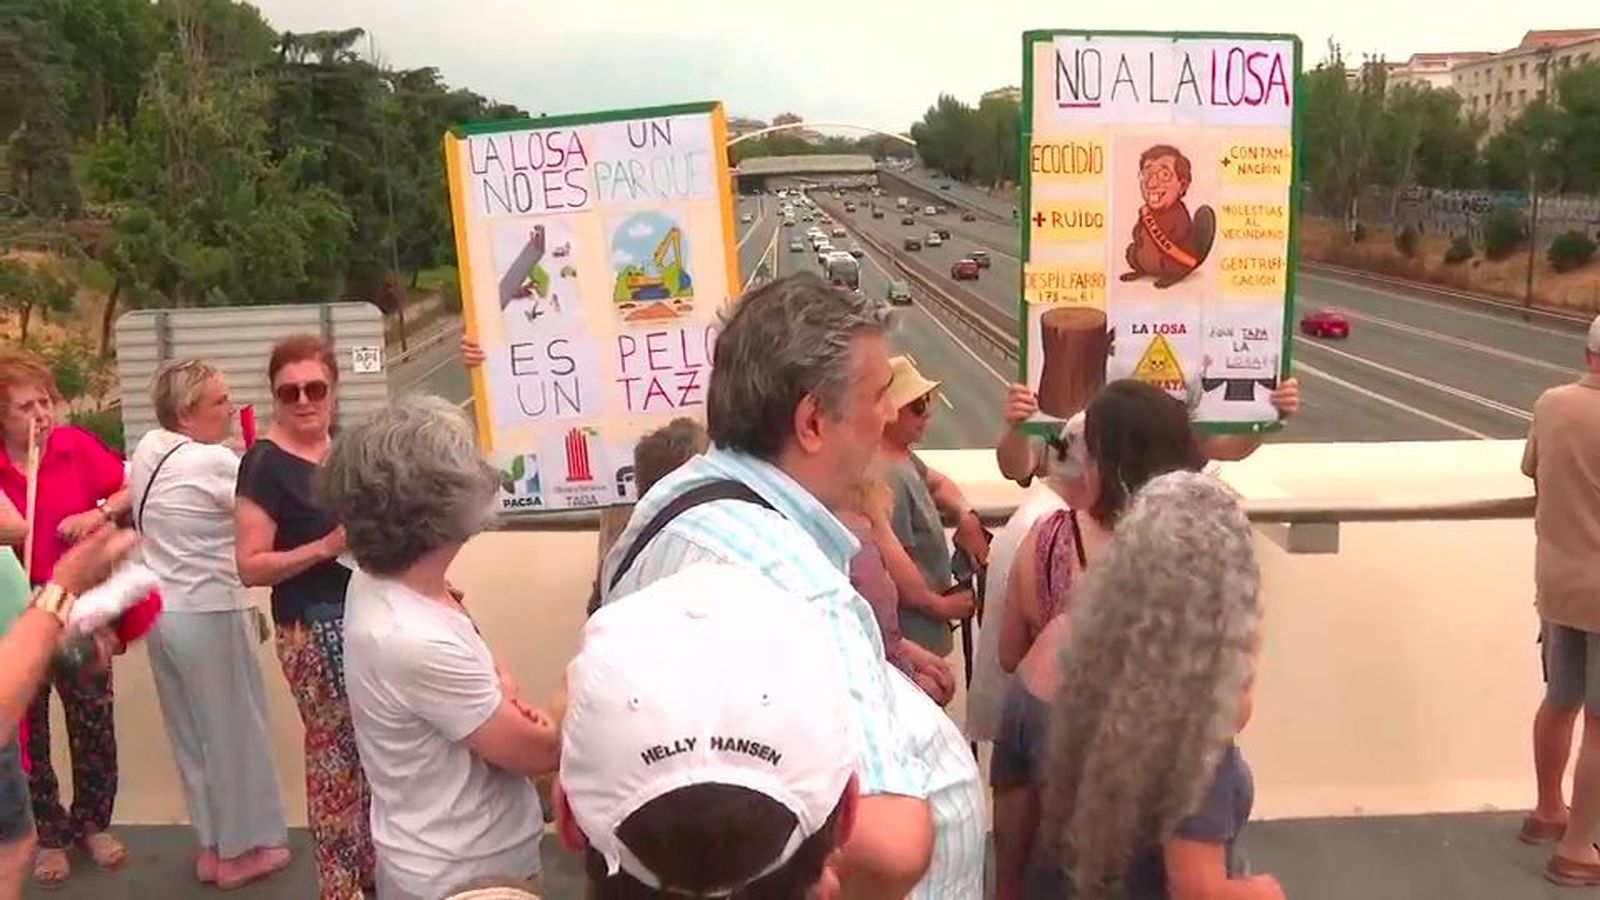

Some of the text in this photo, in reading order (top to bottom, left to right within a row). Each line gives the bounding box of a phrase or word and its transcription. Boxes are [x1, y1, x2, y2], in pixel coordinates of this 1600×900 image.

[1055, 47, 1290, 106] NO A LA LOSA
[627, 119, 672, 148] UN
[468, 131, 588, 174] LA LOSA
[1032, 142, 1104, 174] ECOCIDIO
[483, 168, 588, 214] NO ES
[593, 151, 709, 200] PARQUE
[1052, 208, 1104, 228] RUIDO
[1132, 324, 1187, 334] LA LOSA
[1242, 327, 1268, 338] TAPA
[511, 339, 576, 376] ES
[1233, 341, 1250, 352] LA
[517, 377, 581, 416] UN
[616, 370, 703, 411] TAZ
[503, 496, 542, 507] PACSA
[641, 736, 782, 766] HELLY HANSEN
